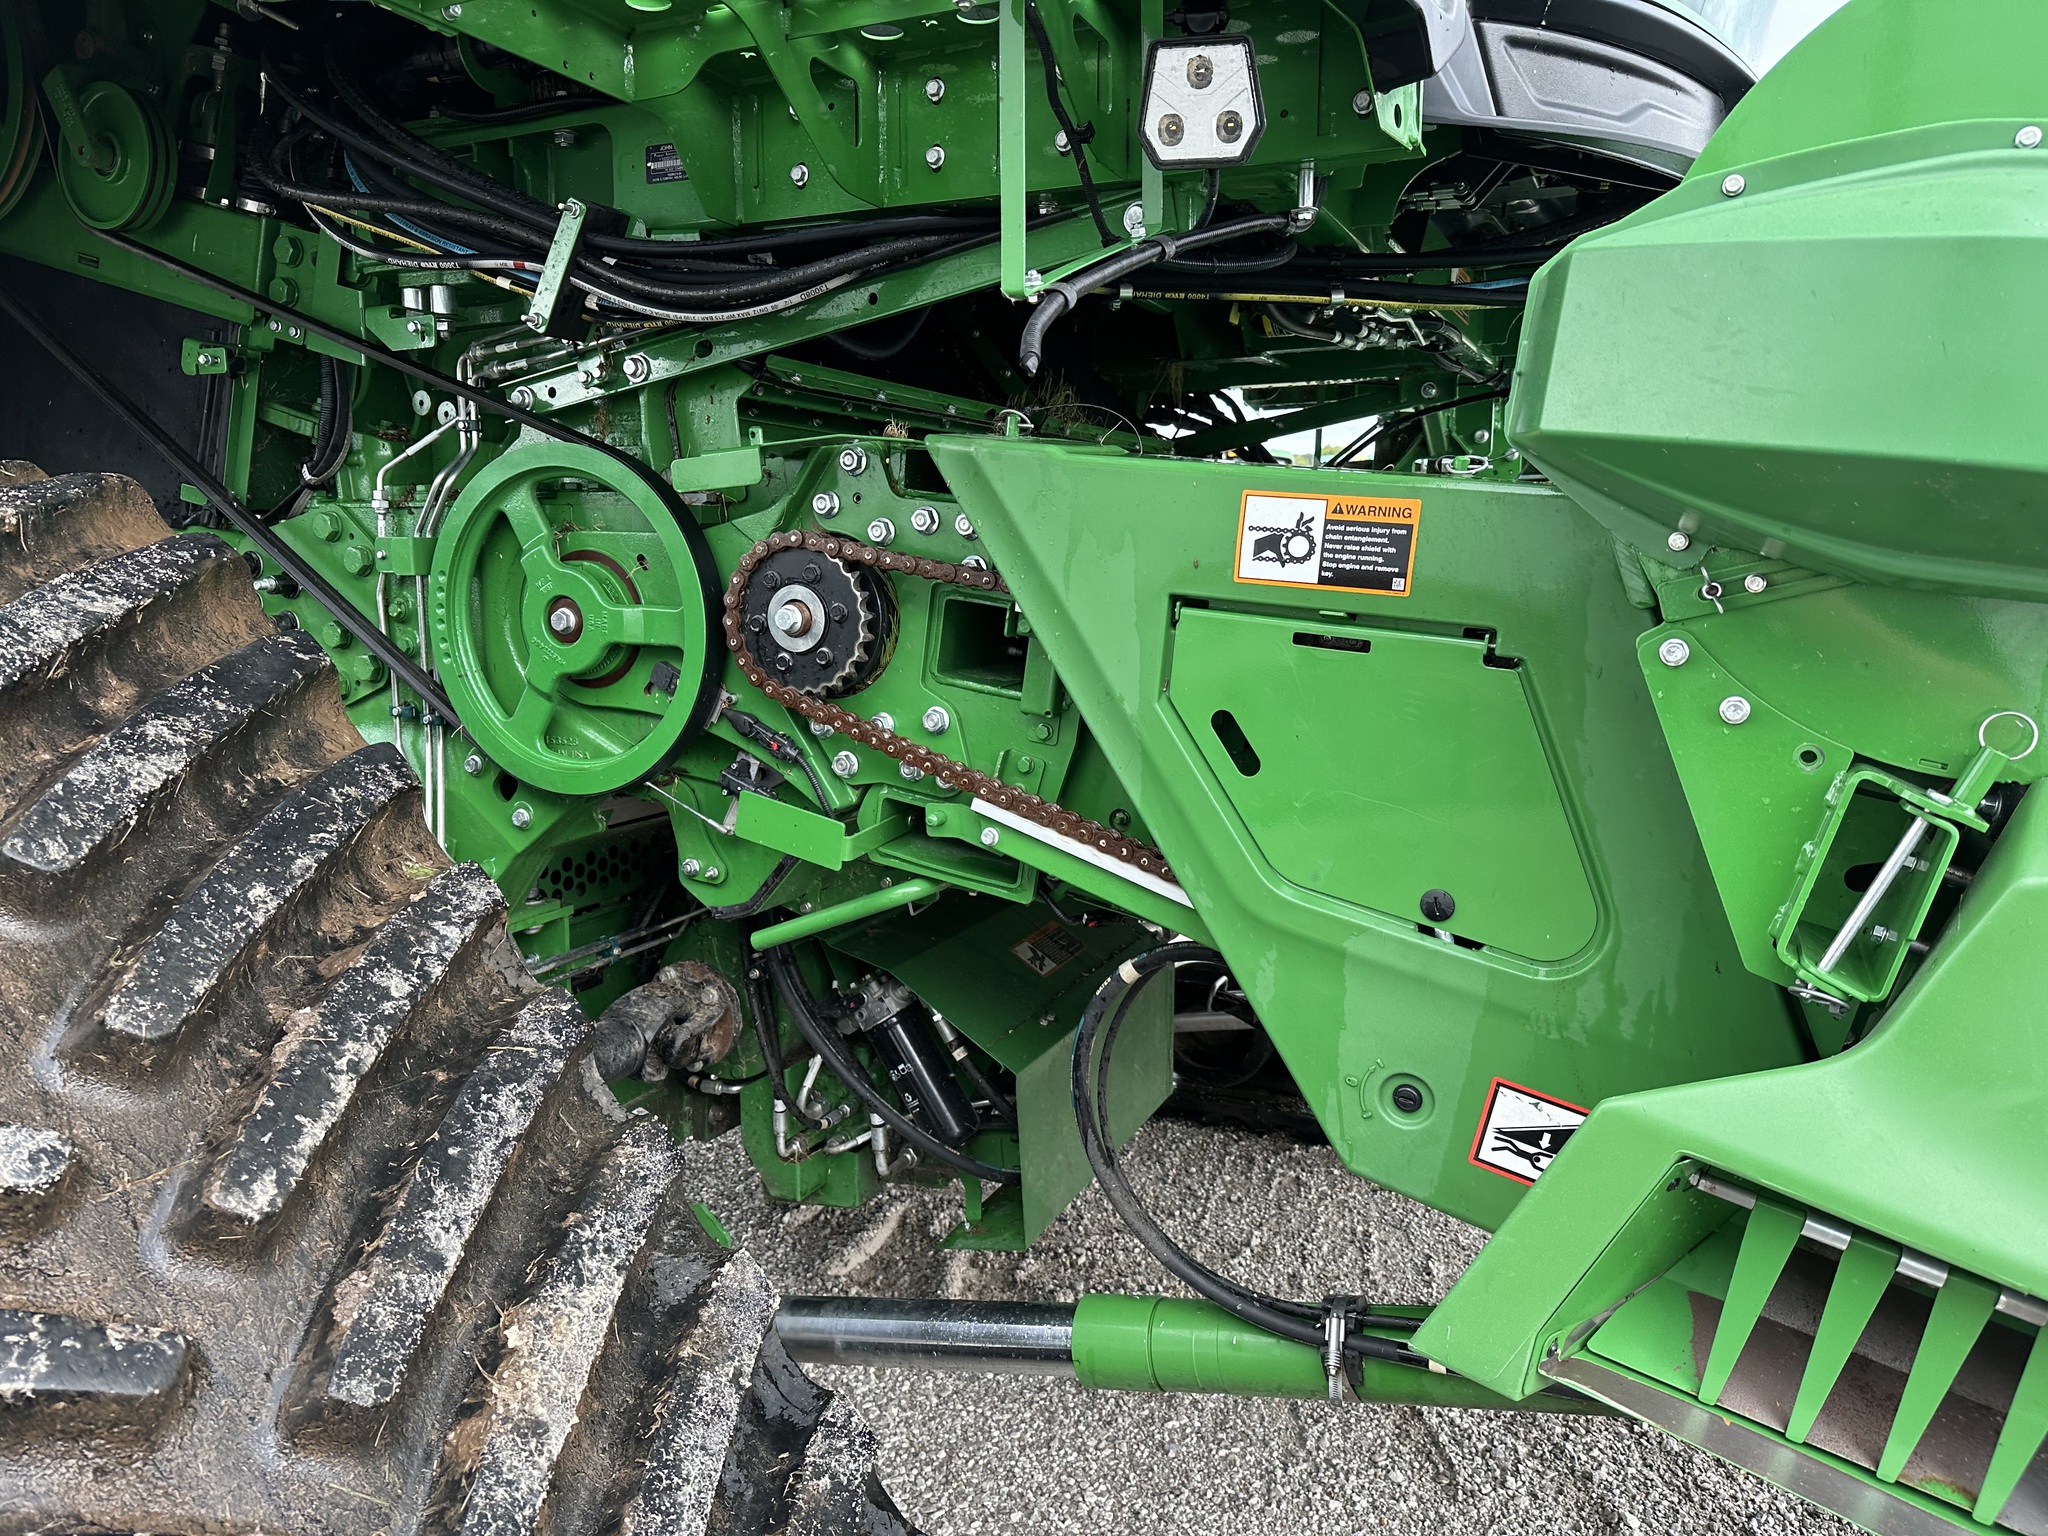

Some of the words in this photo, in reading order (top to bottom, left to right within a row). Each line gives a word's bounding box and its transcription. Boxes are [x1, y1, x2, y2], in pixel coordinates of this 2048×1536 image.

[387, 257, 419, 268] DIEHARD
[799, 283, 830, 301] T3008D
[1133, 290, 1162, 299] DIEHA
[1165, 292, 1185, 300] RYCO
[1187, 292, 1210, 301] T4000
[737, 310, 751, 319] MAX
[752, 305, 769, 315] DN12
[606, 321, 641, 330] DIEHARD
[1346, 504, 1412, 519] WARNING
[1326, 523, 1345, 531] Avoid
[1346, 525, 1370, 533] serious
[1371, 526, 1391, 535] injury
[1325, 533, 1343, 541] chain
[1344, 534, 1390, 544] entanglement.
[1324, 542, 1342, 550] Never
[1343, 543, 1360, 551] raise
[1361, 545, 1381, 553] shield
[1382, 546, 1396, 554] with
[1323, 551, 1334, 559] the
[1334, 553, 1356, 562] engine
[1357, 555, 1384, 563] running.
[1322, 561, 1337, 570] Stop
[1338, 563, 1360, 572] engine
[1361, 563, 1373, 571] and
[1374, 565, 1399, 573] remove
[1321, 570, 1334, 578] key.
